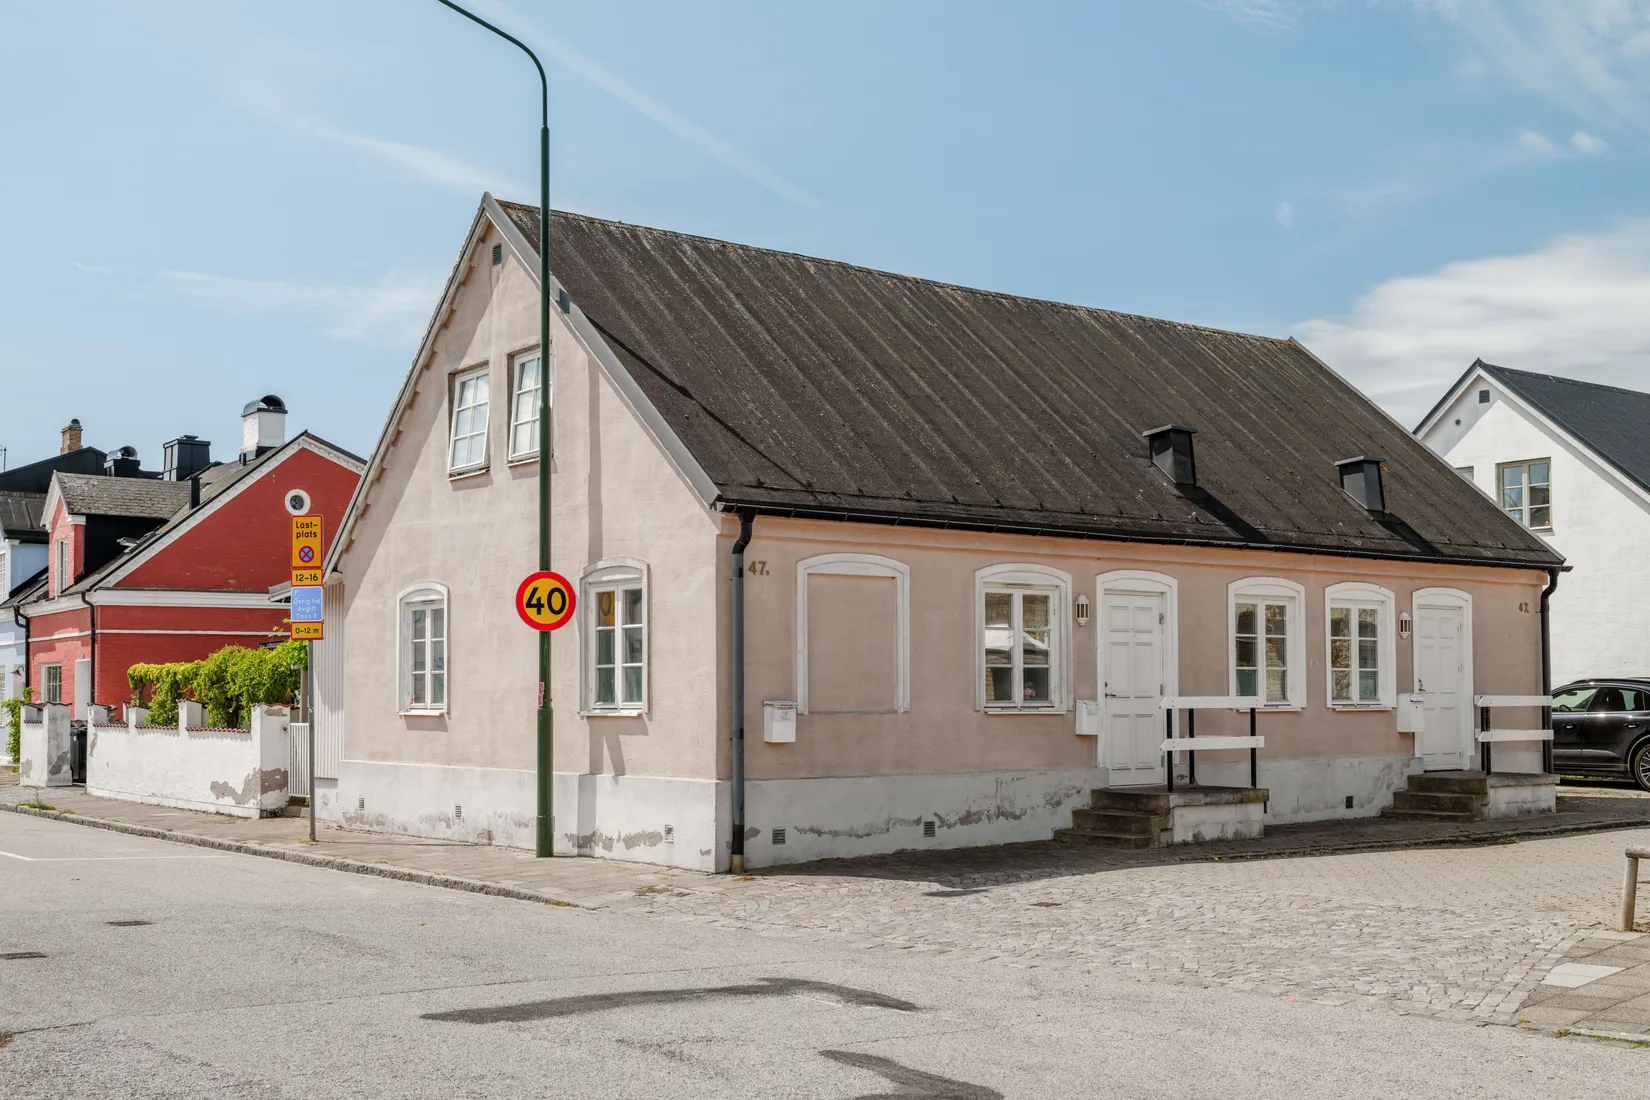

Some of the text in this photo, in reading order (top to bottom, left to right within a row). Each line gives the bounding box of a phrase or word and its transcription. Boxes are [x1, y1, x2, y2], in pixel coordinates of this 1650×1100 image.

[295, 521, 318, 529] Last-
[296, 530, 318, 540] plats
[293, 596, 311, 606] Övrig
[525, 586, 567, 615] 40
